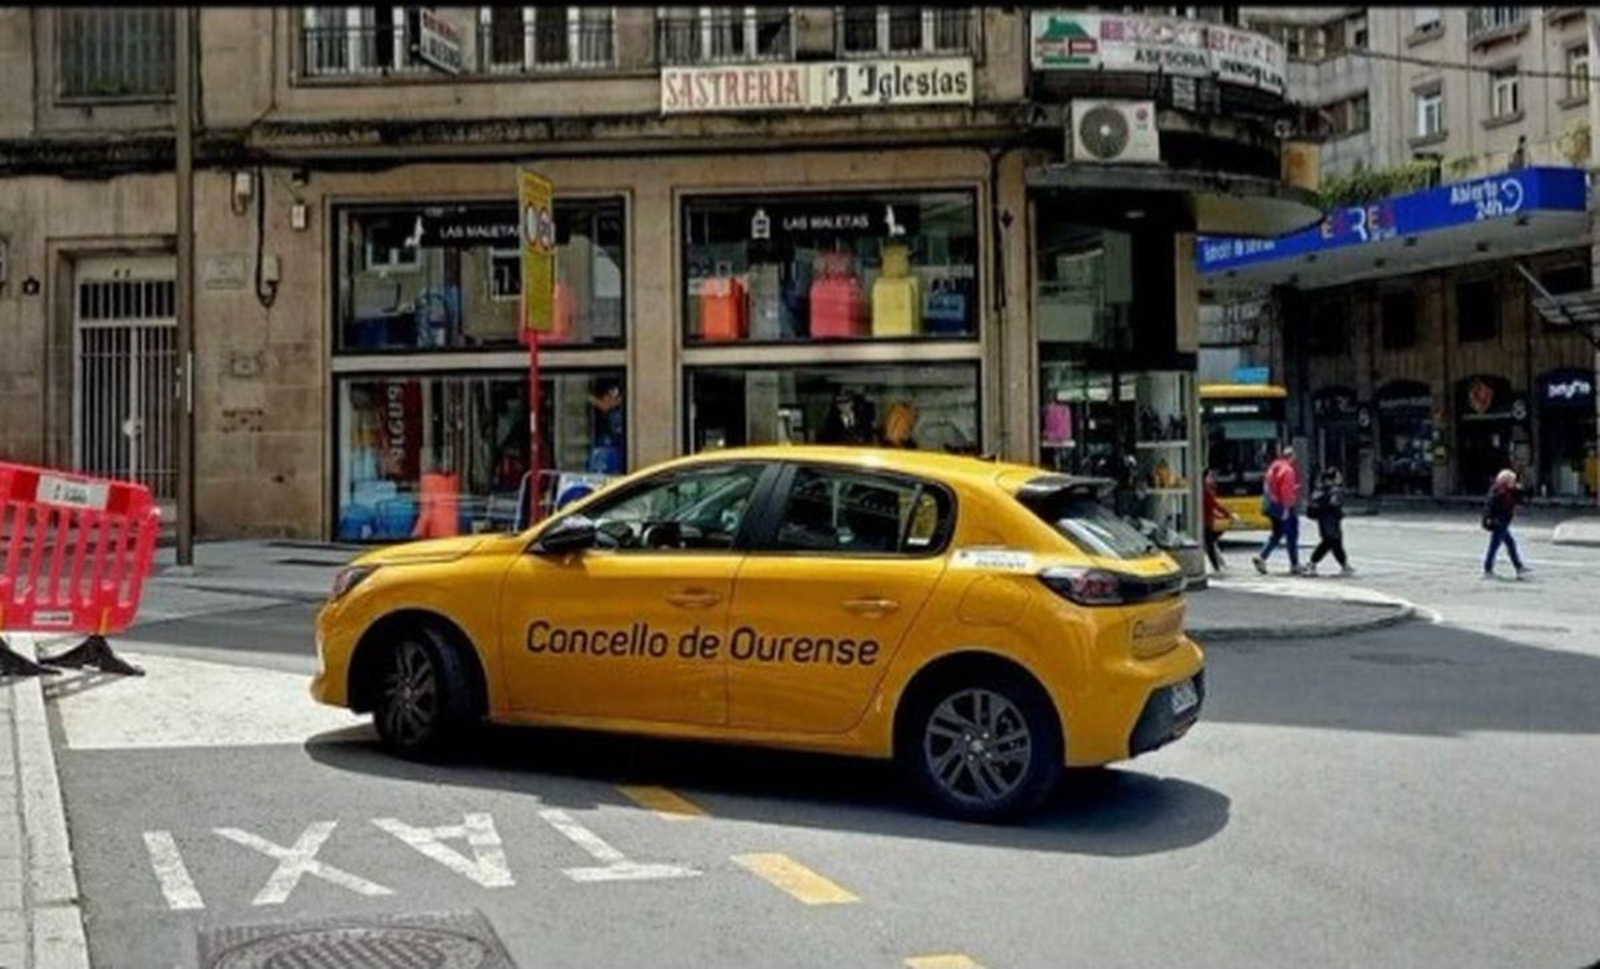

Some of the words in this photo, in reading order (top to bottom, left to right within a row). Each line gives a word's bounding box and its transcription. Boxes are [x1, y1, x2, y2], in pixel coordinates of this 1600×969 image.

[665, 68, 800, 108] SASTRERIA
[440, 225, 464, 239] LAS
[466, 224, 520, 239] MALETA
[783, 216, 808, 230] LAS
[810, 213, 870, 230] MALETAS
[526, 620, 669, 658] Concello
[677, 625, 720, 660] de
[730, 626, 880, 666] Ourense
[142, 805, 704, 910] TAXI
